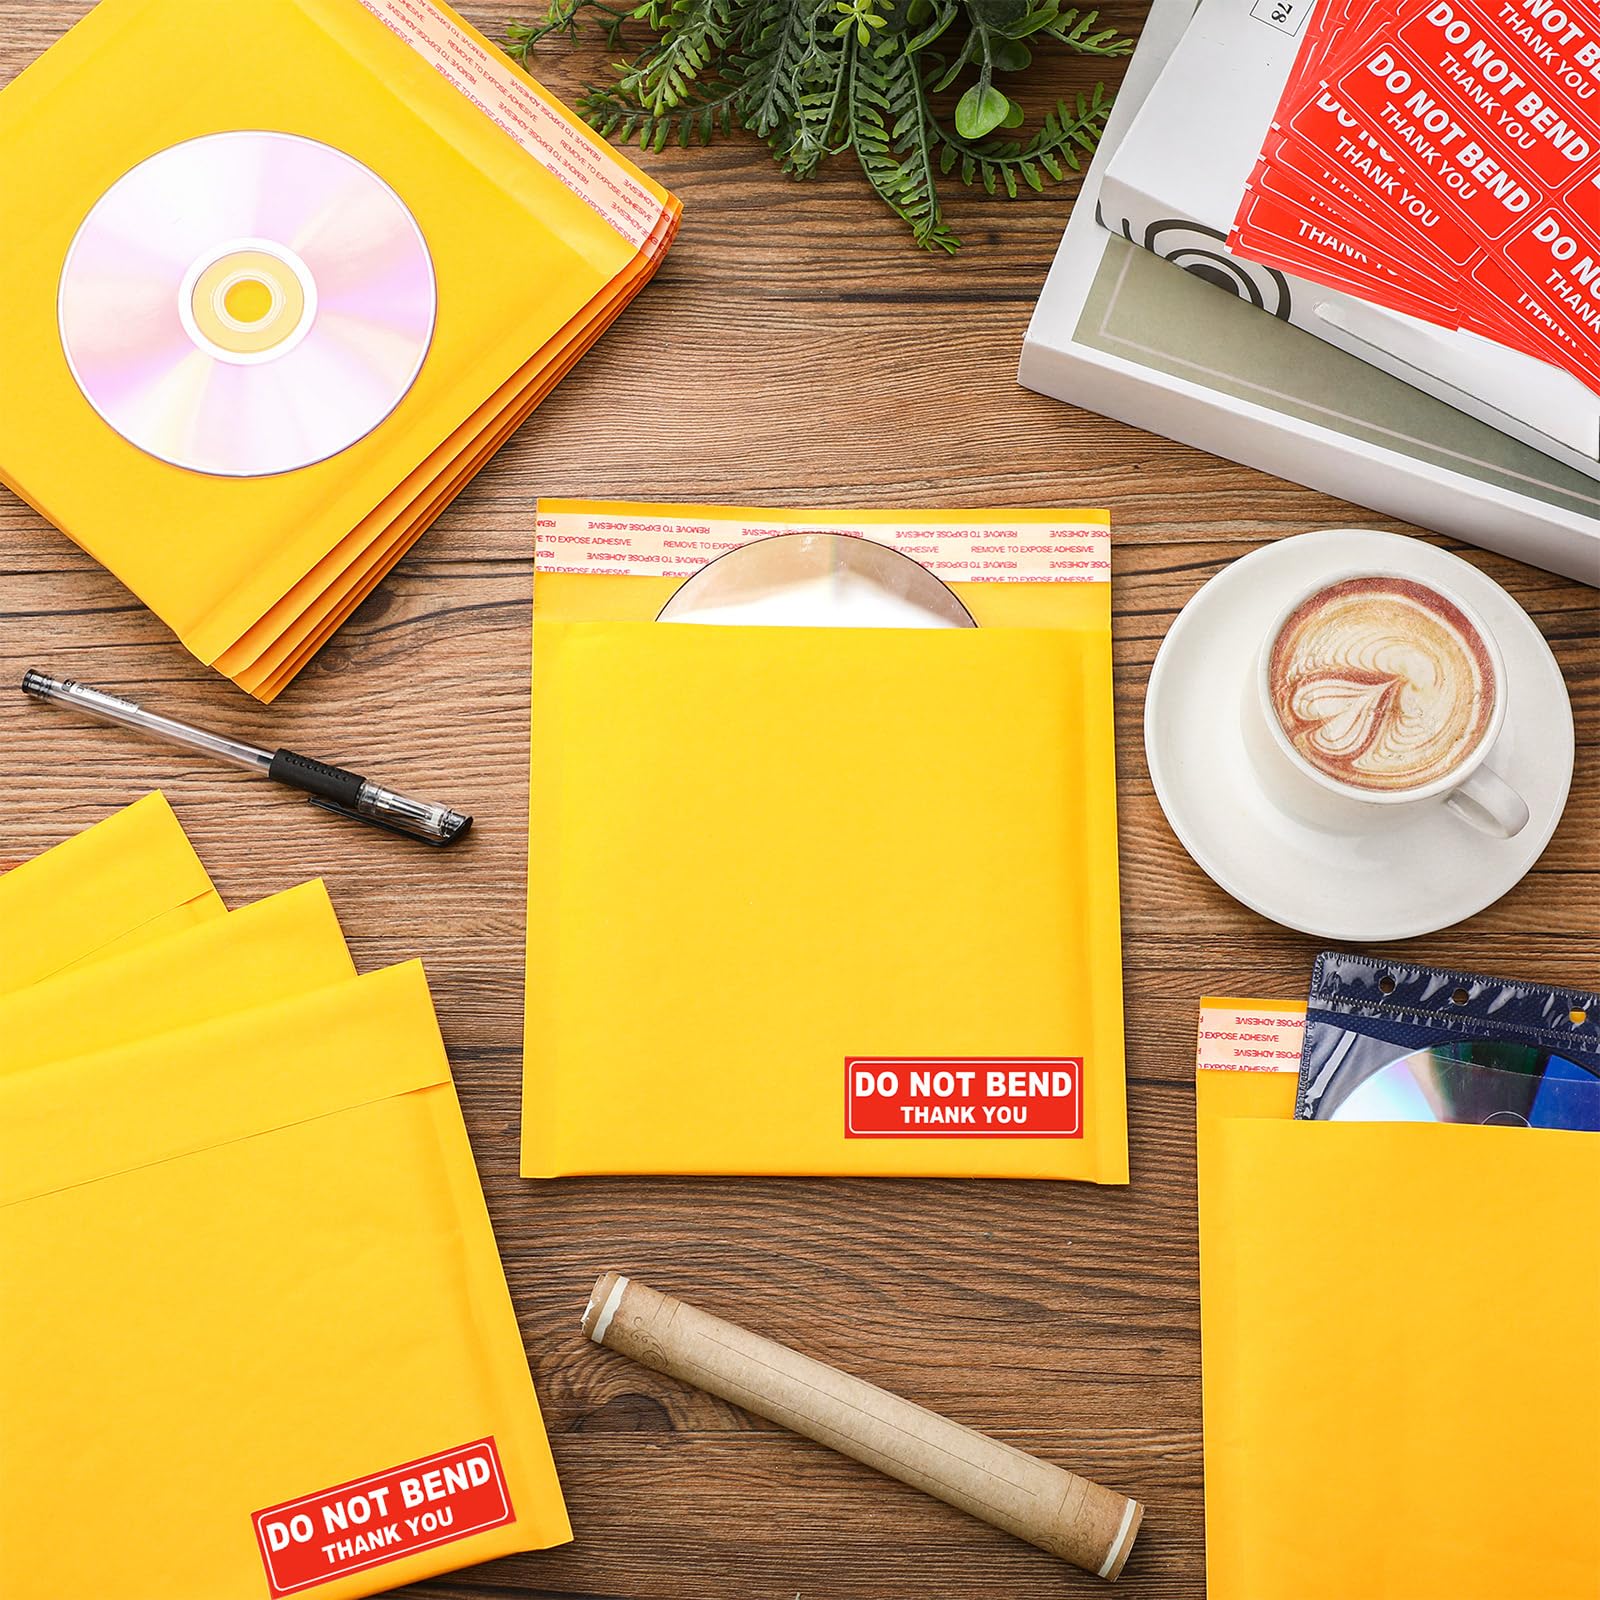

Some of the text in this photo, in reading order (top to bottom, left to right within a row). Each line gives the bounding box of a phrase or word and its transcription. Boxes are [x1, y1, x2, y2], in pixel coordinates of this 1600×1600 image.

[385, 1, 478, 85] REMOVE TO EXPOSE ADHESIVE
[1498, 2, 1560, 66] THANK
[1556, 59, 1596, 99] YOU
[446, 38, 539, 122] REMOVE TO EXPOSE ADHESIVE
[1425, 1, 1471, 44] DO
[1463, 40, 1526, 96] NOT
[1514, 91, 1590, 162] BEND
[1438, 51, 1537, 150] THANK YOU
[509, 79, 601, 162] REMOVE TO EXPOSE ADHESIVE
[1366, 51, 1412, 94] DO
[1405, 89, 1467, 146] NOT
[1455, 141, 1530, 213] BEND
[496, 100, 590, 184] REMOVE TO EXPOSE ADHESIVE
[1379, 101, 1442, 165] THANK
[1437, 160, 1478, 200] YOU
[558, 138, 653, 223] REMOVE TO EXPOSE ADHESIVE
[622, 178, 655, 208] ADHESIVE
[1335, 136, 1401, 196] THANK
[1398, 188, 1441, 228] YOU
[609, 200, 642, 231] ADHESIVE
[1531, 215, 1578, 261] DO
[588, 521, 711, 534] REMOVE TO EXPOSE ADHESIVE
[969, 530, 981, 538] TO
[983, 530, 1018, 538] REMOVE
[1049, 530, 1089, 538] ADHESIVE
[545, 535, 557, 543] TO
[558, 536, 591, 545] EXPOSE
[591, 537, 632, 547] ADHESIVE
[663, 541, 698, 550] REMOVE
[700, 542, 711, 550] TO
[900, 546, 939, 554] ADHESIVE
[586, 552, 709, 565] REMOVE TO EXPOSE ADHESIVE
[936, 561, 968, 569] EXPOSE
[969, 561, 981, 569] TO
[983, 561, 1018, 569] REMOVE
[1049, 561, 1089, 569] ADHESIVE
[1235, 1016, 1276, 1026] ADHESIVE
[1205, 1031, 1238, 1041] EXPOSE
[1238, 1033, 1279, 1042] ADHESIVE
[1233, 1048, 1274, 1058] ADHESIVE
[855, 1071, 1072, 1097] DO NOT BEND
[900, 1106, 1027, 1124] THANK YOU
[266, 1456, 491, 1552] DO NOT BEND
[321, 1506, 454, 1564] THANK YOU
